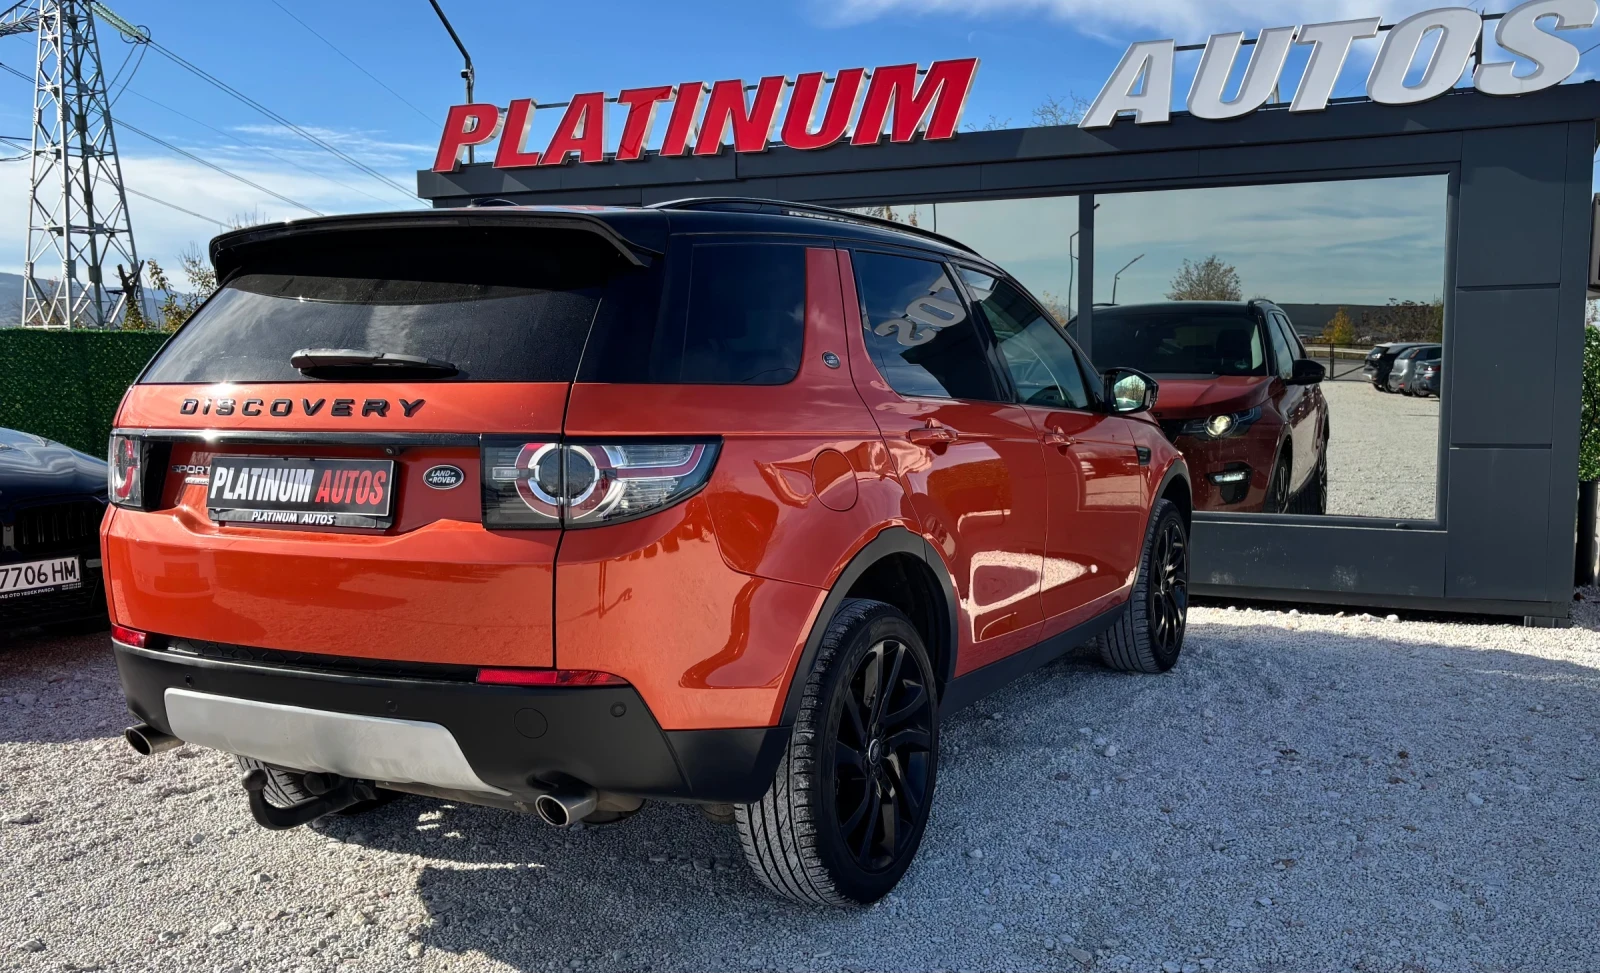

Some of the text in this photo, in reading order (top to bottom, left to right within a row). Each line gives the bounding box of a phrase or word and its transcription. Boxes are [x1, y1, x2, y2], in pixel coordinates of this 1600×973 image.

[432, 0, 1598, 173] PLATINUM AUTOS
[180, 398, 426, 417] DISCOVERY
[172, 465, 211, 474] SPORT
[210, 466, 387, 505] PLATINUM AUTOS
[251, 511, 335, 525] PLATINUM AUTOS
[0, 560, 77, 589] 7706 HM
